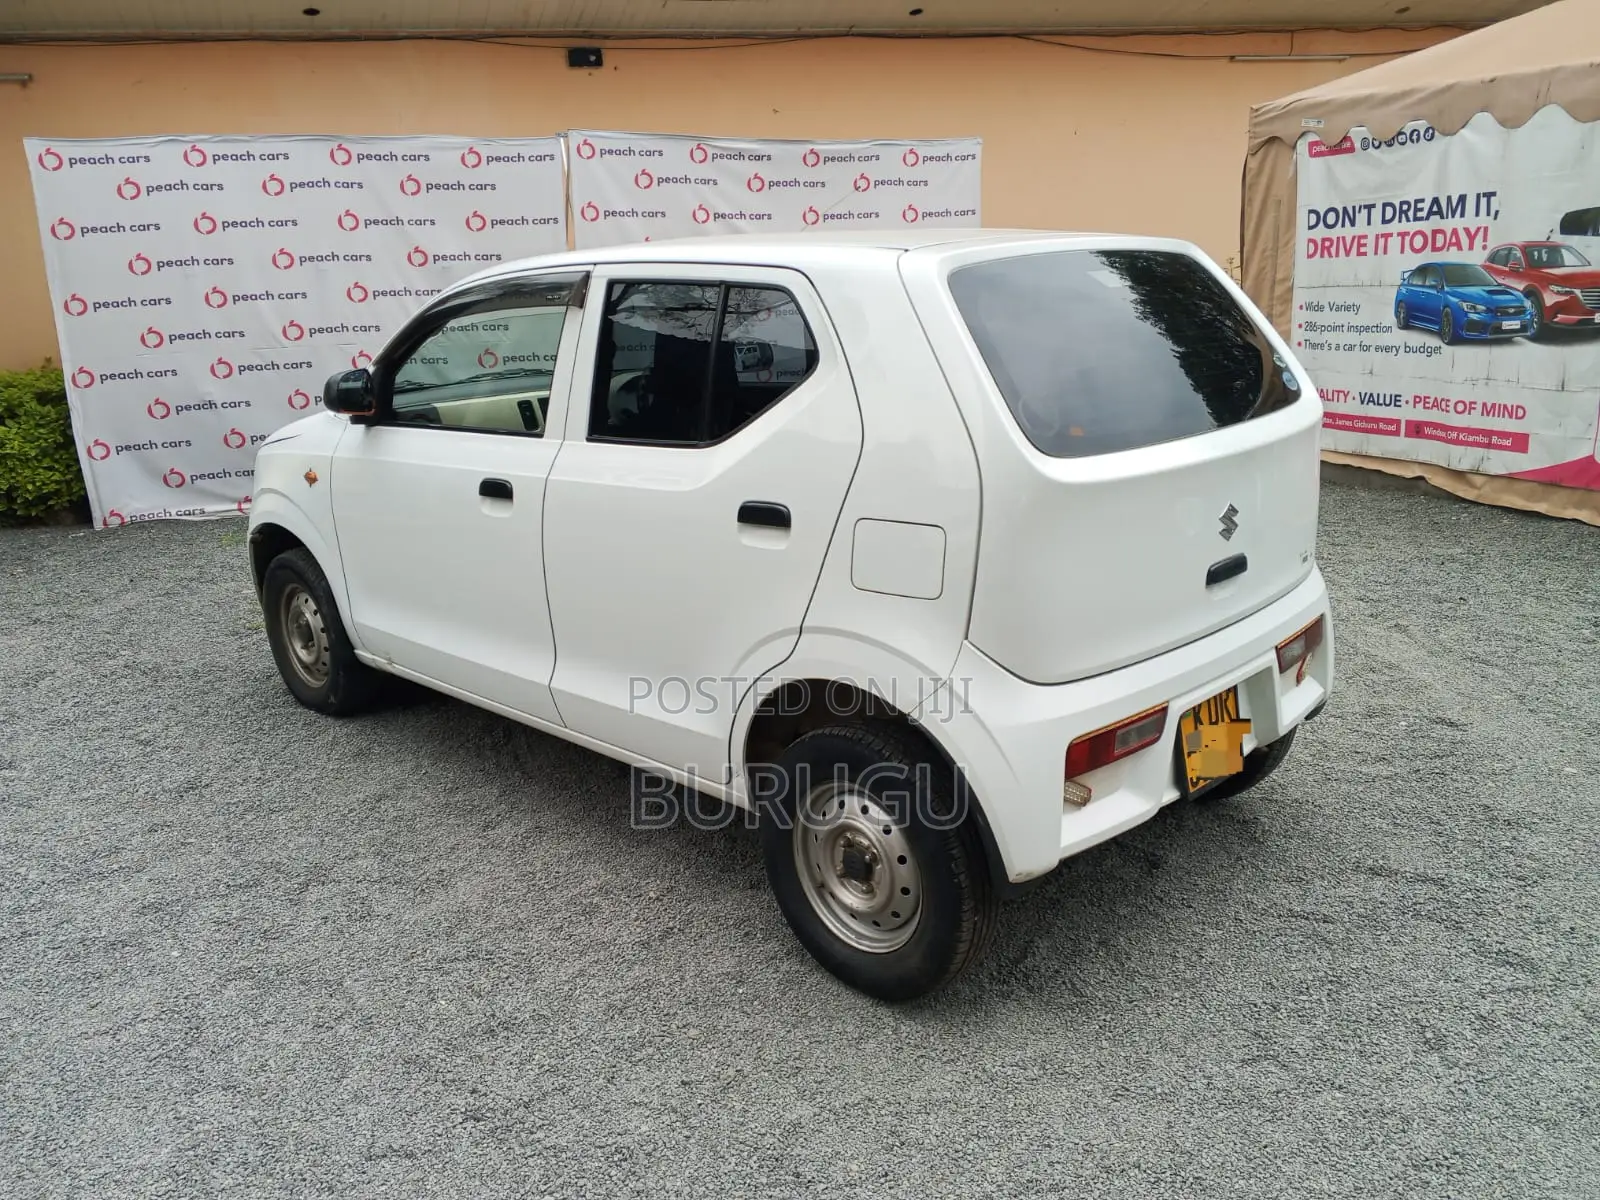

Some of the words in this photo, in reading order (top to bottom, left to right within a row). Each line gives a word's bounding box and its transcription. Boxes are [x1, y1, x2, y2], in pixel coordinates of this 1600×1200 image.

[213, 151, 253, 164] peach
[258, 152, 290, 161] cars
[357, 152, 399, 163] peach
[401, 154, 430, 162] cars
[487, 153, 526, 165] peach
[527, 153, 555, 162] cars
[600, 147, 636, 158] peach
[638, 149, 664, 157] cars
[712, 152, 746, 162] peach
[747, 154, 772, 162] cars
[824, 153, 856, 165] peach
[857, 154, 880, 162] cars
[923, 153, 953, 164] peach
[954, 153, 977, 162] cars
[69, 154, 115, 168] peach
[118, 155, 151, 165] cars
[289, 178, 331, 191] peach
[333, 181, 364, 190] cars
[426, 181, 466, 193] peach
[468, 183, 497, 191] cars
[658, 175, 692, 186] peach
[694, 177, 718, 186] cars
[769, 178, 801, 190] peach
[802, 180, 826, 188] cars
[874, 178, 905, 189] peach
[906, 179, 929, 187] cars
[147, 180, 190, 196] peach
[192, 183, 224, 191] cars
[604, 208, 639, 219] peach
[641, 210, 667, 218] cars
[714, 211, 748, 221] peach
[748, 213, 773, 221] cars
[824, 211, 855, 222] peach
[856, 211, 880, 220] cars
[922, 209, 953, 219] peach
[953, 209, 976, 217] cars
[1307, 204, 1376, 230] DON'T
[1381, 193, 1467, 225] DREAM
[1474, 191, 1500, 221] IT,
[222, 218, 265, 231] peach
[267, 219, 298, 228] cars
[364, 216, 405, 228] peach
[407, 218, 436, 226] cars
[491, 216, 529, 229] peach
[531, 217, 559, 226] cars
[81, 223, 126, 237] peach
[129, 223, 161, 233] cars
[1306, 234, 1368, 259] DRIVE
[1373, 232, 1394, 256] IT
[1397, 226, 1489, 255] TODAY!
[157, 256, 200, 271] peach
[203, 257, 234, 266] cars
[300, 252, 340, 265] peach
[342, 254, 372, 262] cars
[433, 252, 472, 264] peach
[232, 291, 275, 304] peach
[277, 291, 308, 300] cars
[373, 287, 413, 300] peach
[93, 297, 137, 312] peach
[140, 297, 172, 307] cars
[1305, 301, 1325, 313] Wide
[1328, 300, 1361, 315] Variety
[309, 323, 350, 337] peach
[351, 324, 381, 333] cars
[441, 322, 479, 334] peach
[481, 324, 510, 332] cars
[1304, 322, 1345, 336] 286-point
[1347, 322, 1393, 335] inspection
[169, 330, 212, 344] peach
[214, 330, 246, 339] cars
[1304, 340, 1333, 353] There's
[1334, 344, 1341, 352] a
[1342, 344, 1357, 353] car
[1359, 342, 1373, 353] for
[1374, 345, 1401, 357] every
[1404, 342, 1442, 357] budget
[420, 356, 450, 365] cars
[503, 352, 539, 364] peach
[238, 361, 280, 375] peach
[282, 361, 313, 370] cars
[100, 369, 144, 384] peach
[147, 369, 178, 378] cars
[176, 400, 218, 415] peach
[220, 400, 252, 409] cars
[1317, 388, 1350, 403] ALITY
[1359, 392, 1402, 408] VALUE
[1413, 395, 1450, 413] PEACE
[1453, 400, 1477, 415] OF
[1481, 402, 1527, 420] MIND
[1379, 423, 1397, 431] Road
[1459, 432, 1489, 443] Kiambu
[1491, 436, 1513, 446] Road
[116, 440, 159, 455] peach
[161, 439, 192, 449] cars
[190, 468, 232, 484] peach
[234, 469, 255, 478] car
[129, 508, 173, 523] peach
[175, 507, 207, 517] cars
